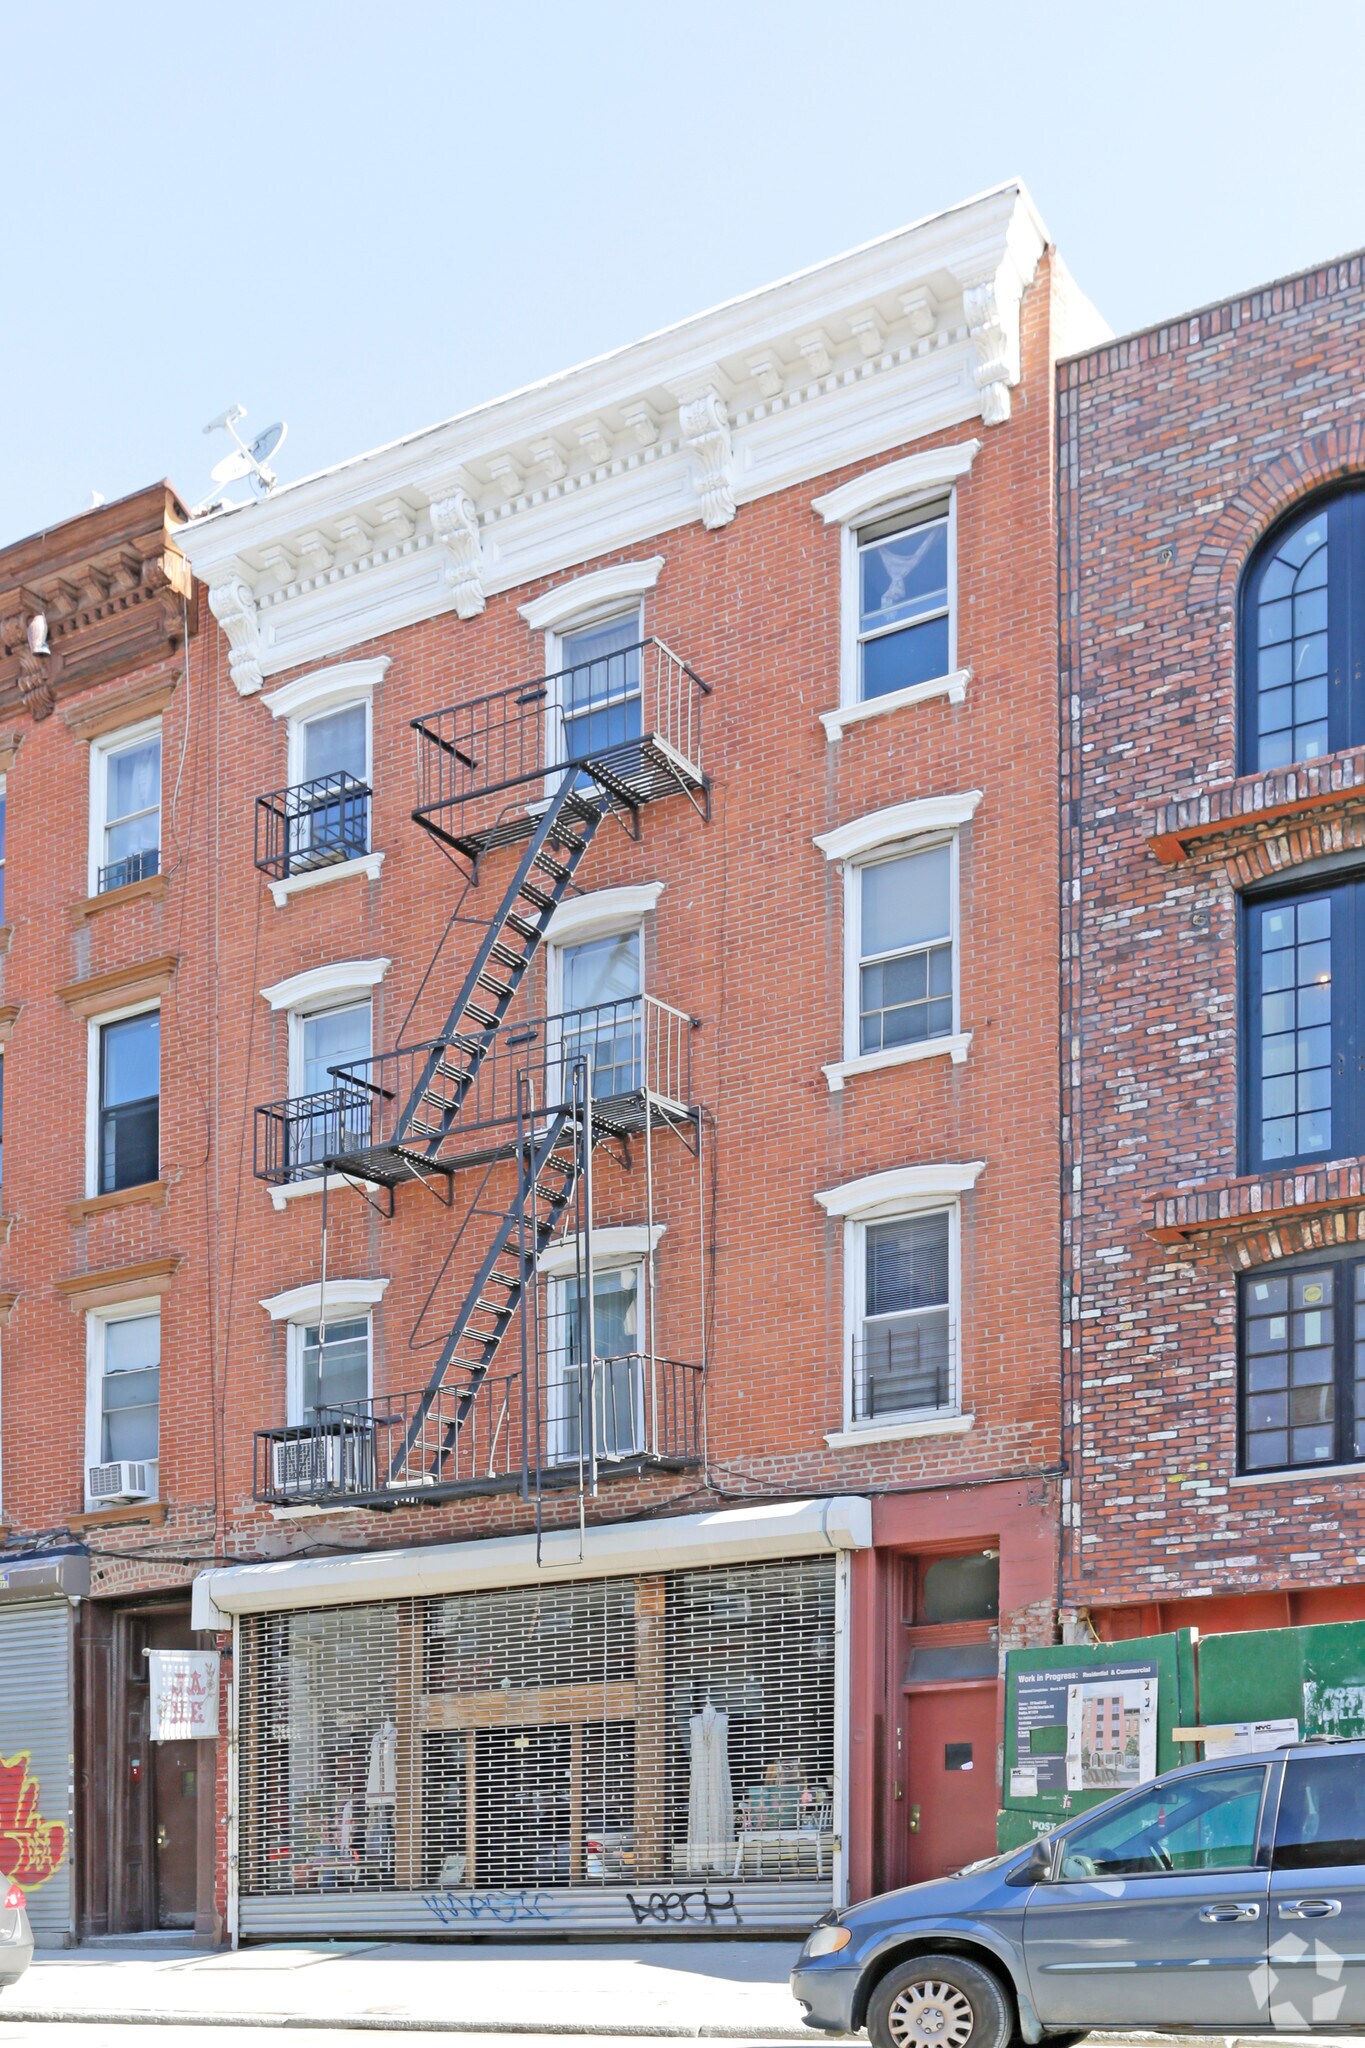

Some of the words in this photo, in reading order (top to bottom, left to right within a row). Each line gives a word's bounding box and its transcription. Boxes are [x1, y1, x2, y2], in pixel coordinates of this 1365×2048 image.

[1018, 1674, 1036, 1683] Work
[1037, 1673, 1044, 1681] in
[1045, 1672, 1079, 1682] Progress:
[1116, 1666, 1151, 1676] Commercial
[1032, 1820, 1057, 1831] POST
